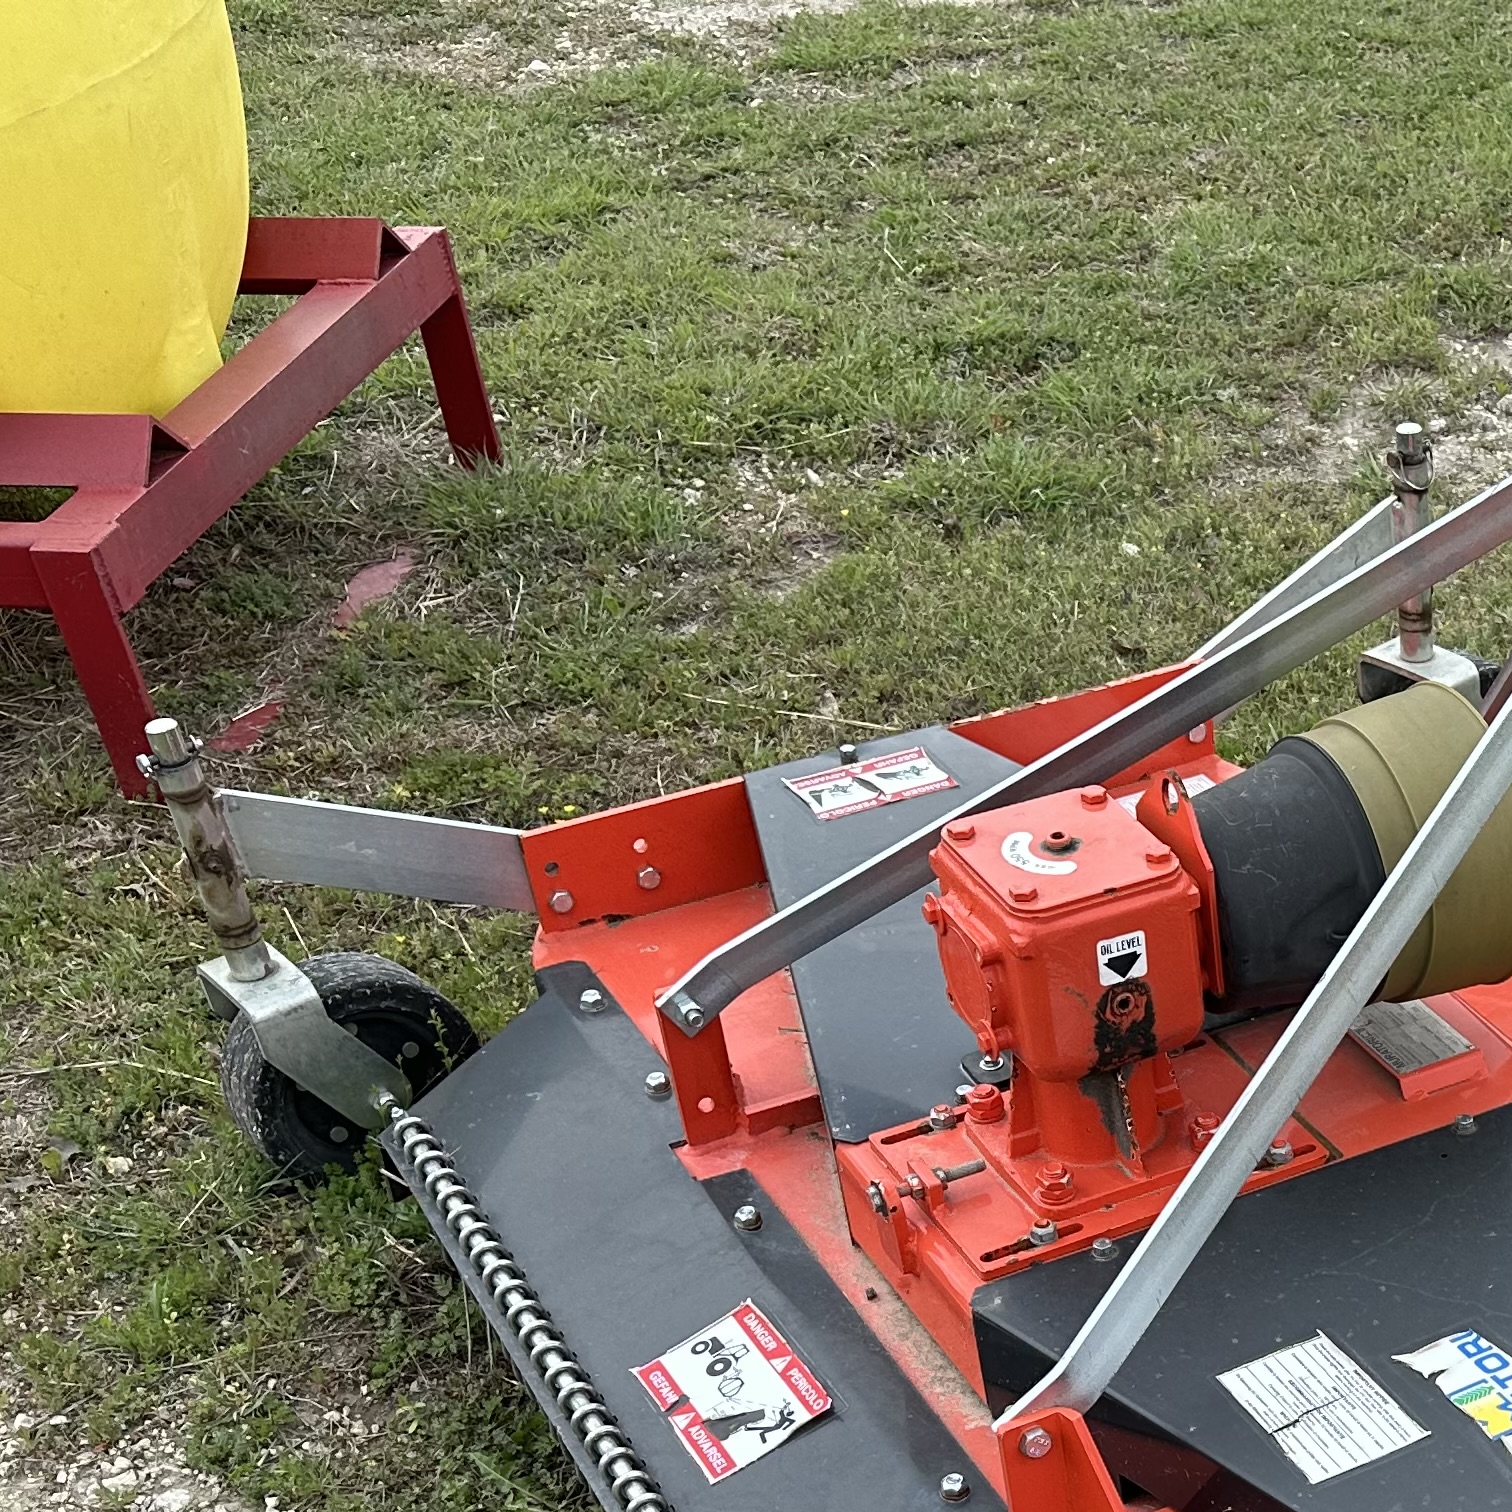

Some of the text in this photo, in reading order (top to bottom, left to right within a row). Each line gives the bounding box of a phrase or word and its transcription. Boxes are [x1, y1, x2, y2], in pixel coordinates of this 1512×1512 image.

[795, 771, 846, 789] ADVARSE
[901, 780, 950, 798] DANGER
[819, 799, 878, 820] PERICOLO
[1100, 935, 1142, 956] OIL LEVEL
[743, 1312, 778, 1352] DANGER
[786, 1367, 825, 1411] PERICOLO
[687, 1425, 728, 1474] ADVARSEL
